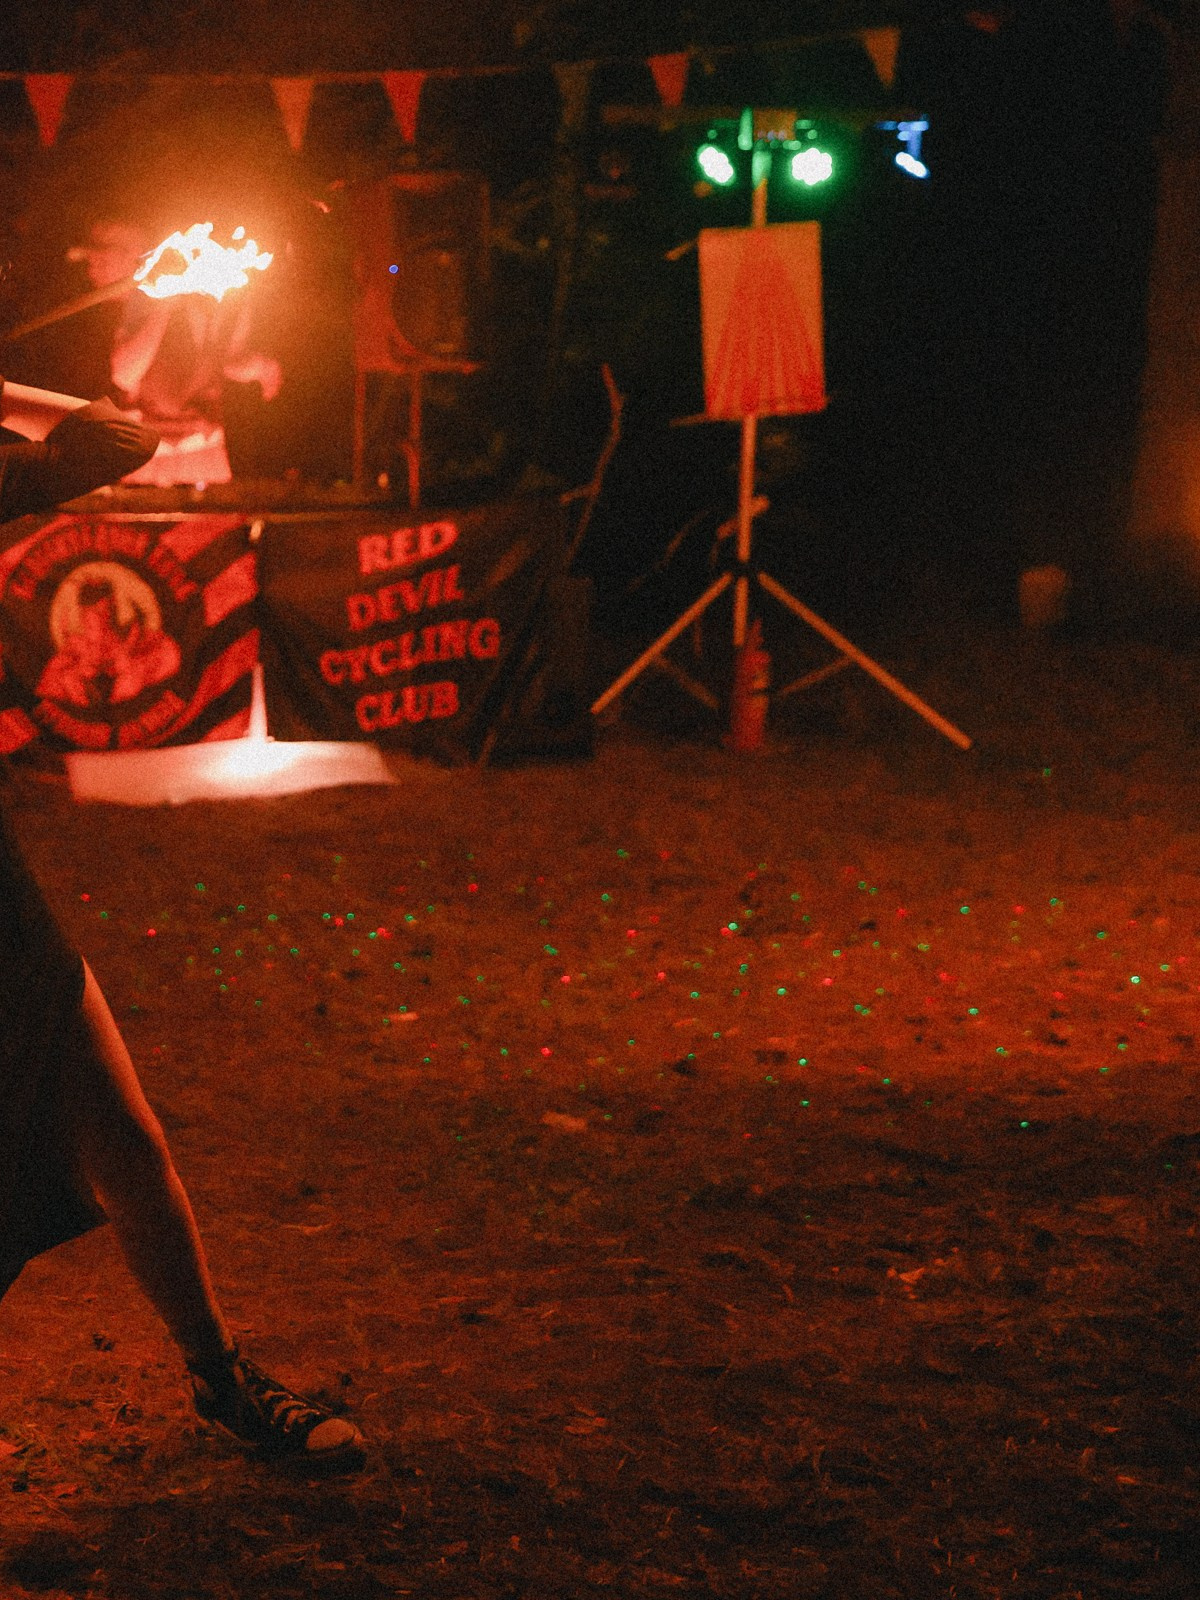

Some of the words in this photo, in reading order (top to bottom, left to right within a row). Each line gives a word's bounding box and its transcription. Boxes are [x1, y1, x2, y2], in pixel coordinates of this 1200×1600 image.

[357, 520, 459, 575] RED
[347, 565, 464, 632] DEVIL
[319, 618, 500, 685] CYCLING
[356, 681, 459, 732] CLUB
